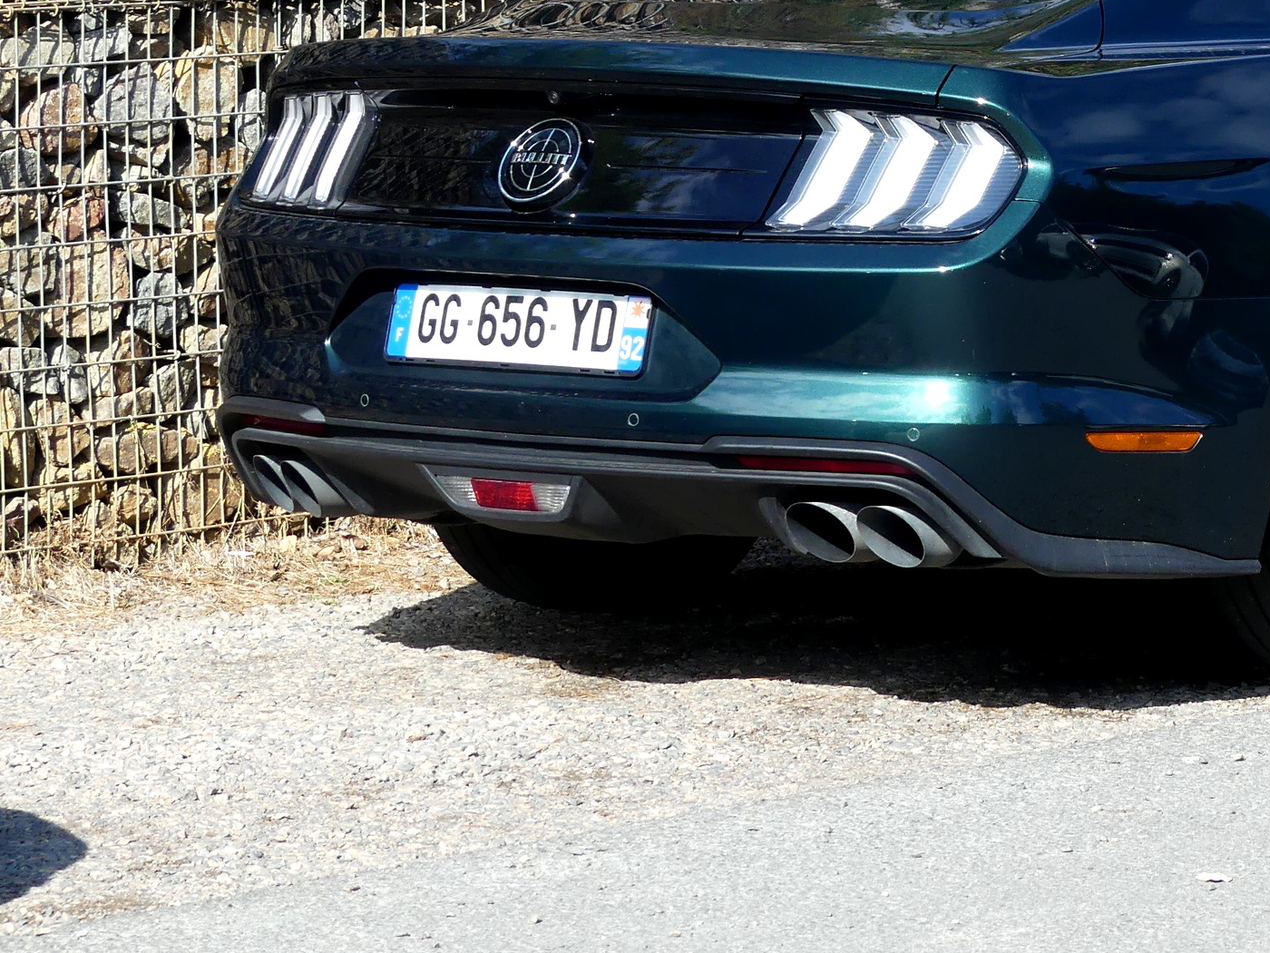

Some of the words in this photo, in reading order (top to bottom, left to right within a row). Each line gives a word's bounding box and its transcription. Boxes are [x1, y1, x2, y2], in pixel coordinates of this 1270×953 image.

[511, 152, 572, 166] BULLITT
[418, 293, 462, 344] GG
[477, 295, 549, 348] 656
[571, 298, 618, 352] YD
[394, 327, 405, 342] F
[619, 335, 645, 361] 92
